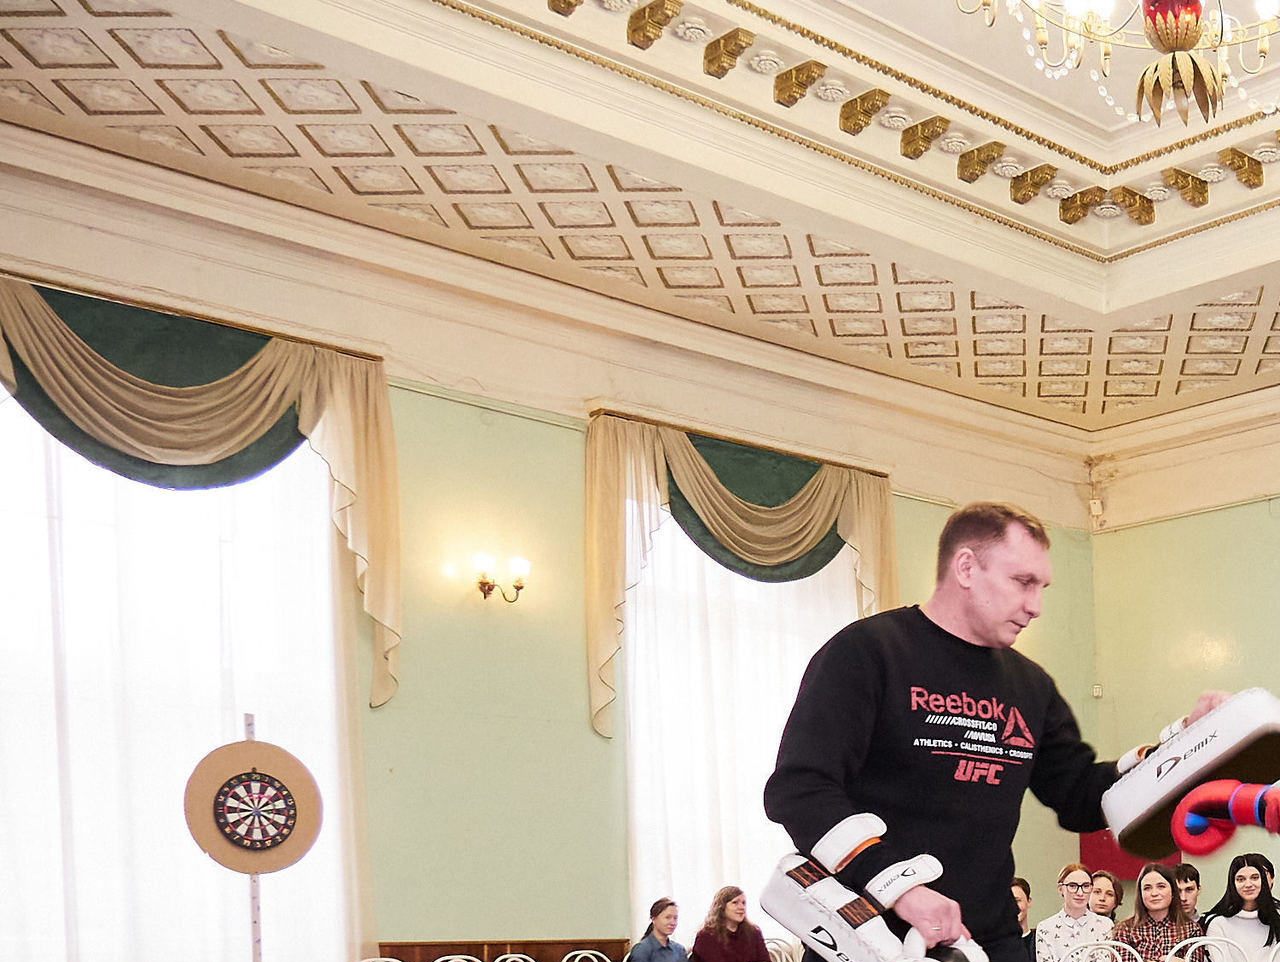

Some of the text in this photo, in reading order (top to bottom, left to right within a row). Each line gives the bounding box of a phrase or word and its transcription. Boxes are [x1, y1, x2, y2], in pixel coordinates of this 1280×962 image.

[909, 686, 1007, 722] Reebok
[913, 738, 953, 749] ATHLETICS
[953, 759, 1005, 786] UFC
